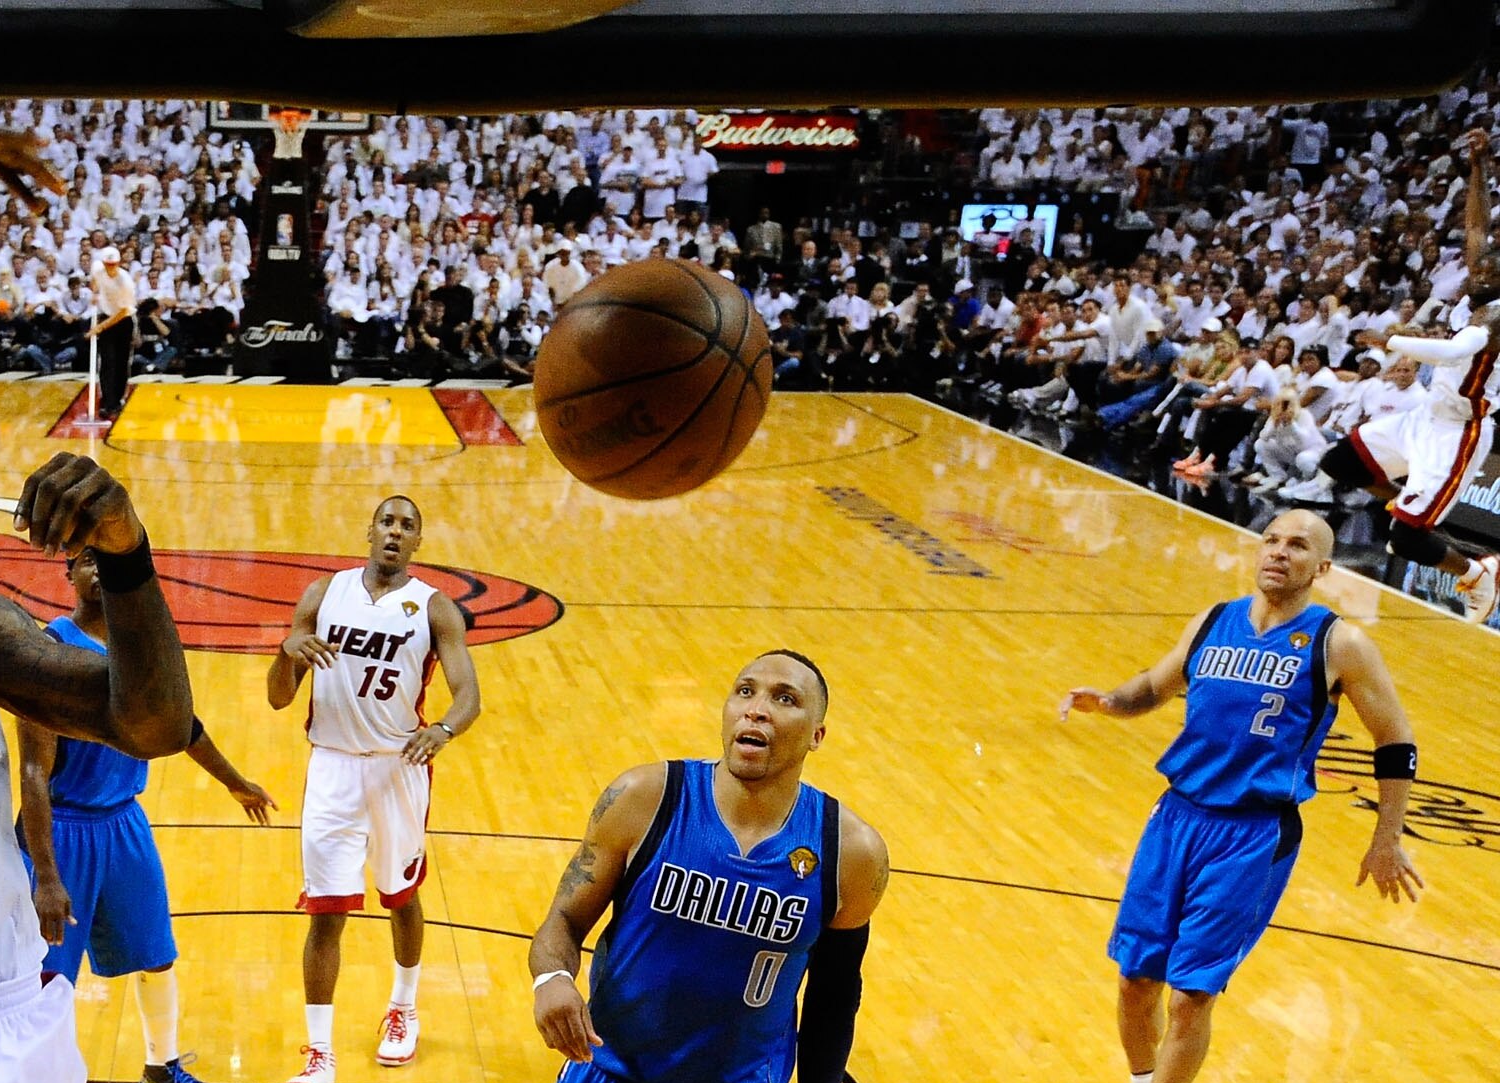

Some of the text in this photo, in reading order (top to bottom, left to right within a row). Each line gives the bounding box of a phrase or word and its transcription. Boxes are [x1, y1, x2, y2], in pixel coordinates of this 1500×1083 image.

[695, 114, 859, 148] Budweiser
[327, 624, 415, 663] HEAT
[357, 665, 401, 702] 15
[1195, 646, 1302, 689] DALLAS
[1249, 691, 1286, 738] 2
[650, 862, 809, 944] DALLAS
[743, 950, 788, 1008] 0
